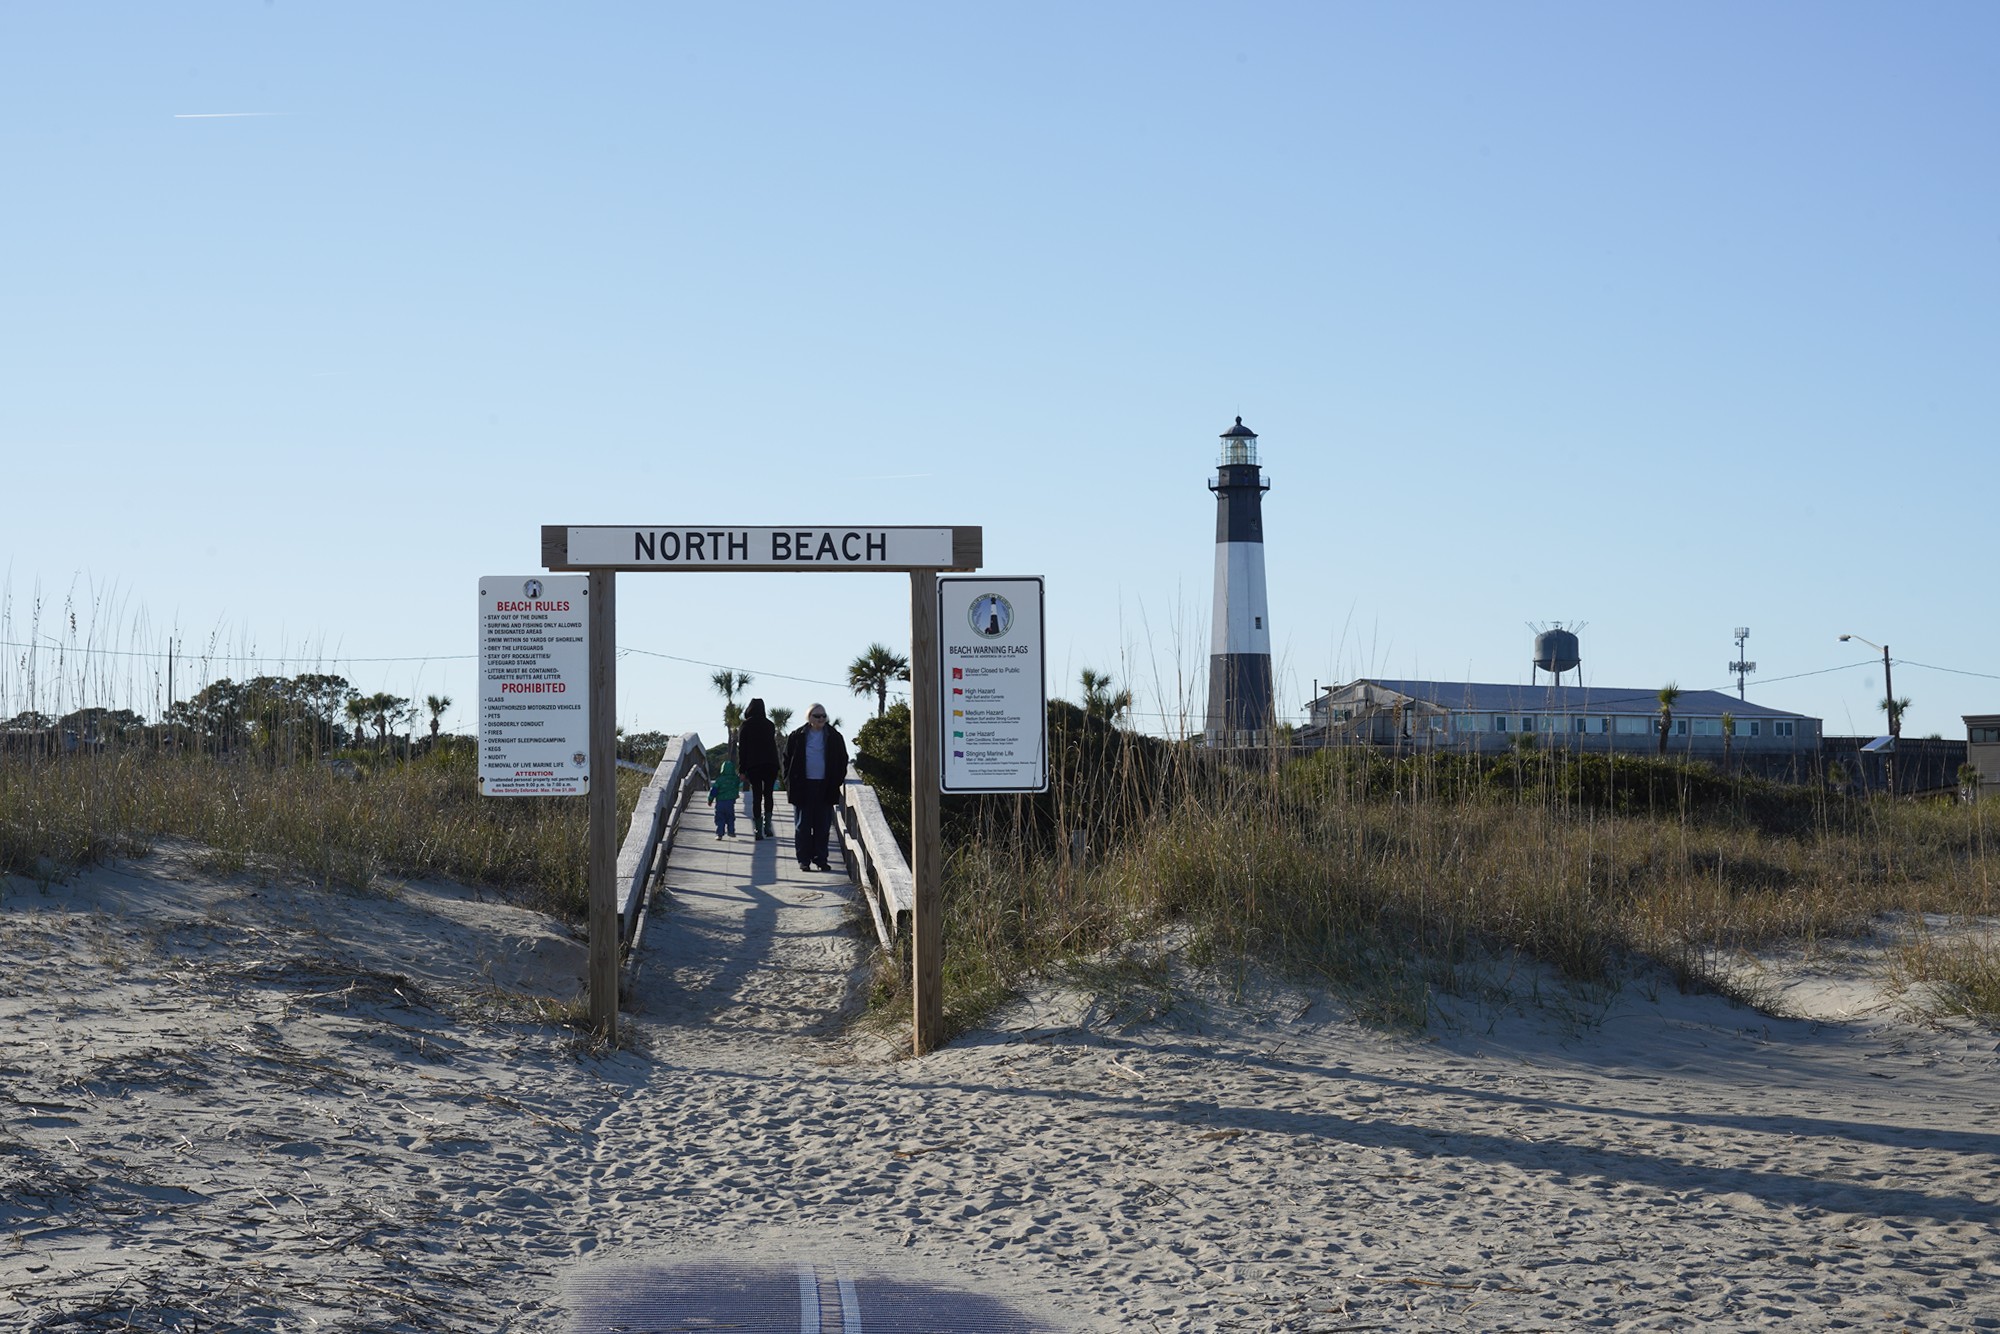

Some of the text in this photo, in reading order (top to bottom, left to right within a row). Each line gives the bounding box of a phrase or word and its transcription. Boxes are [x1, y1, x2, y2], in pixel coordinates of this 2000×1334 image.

[635, 532, 887, 561] NORTH BEACH
[497, 602, 570, 611] BEACH RULES
[950, 646, 971, 654] BEACH
[1008, 646, 1028, 654] FLAGS
[502, 683, 566, 693] PROHIBITED
